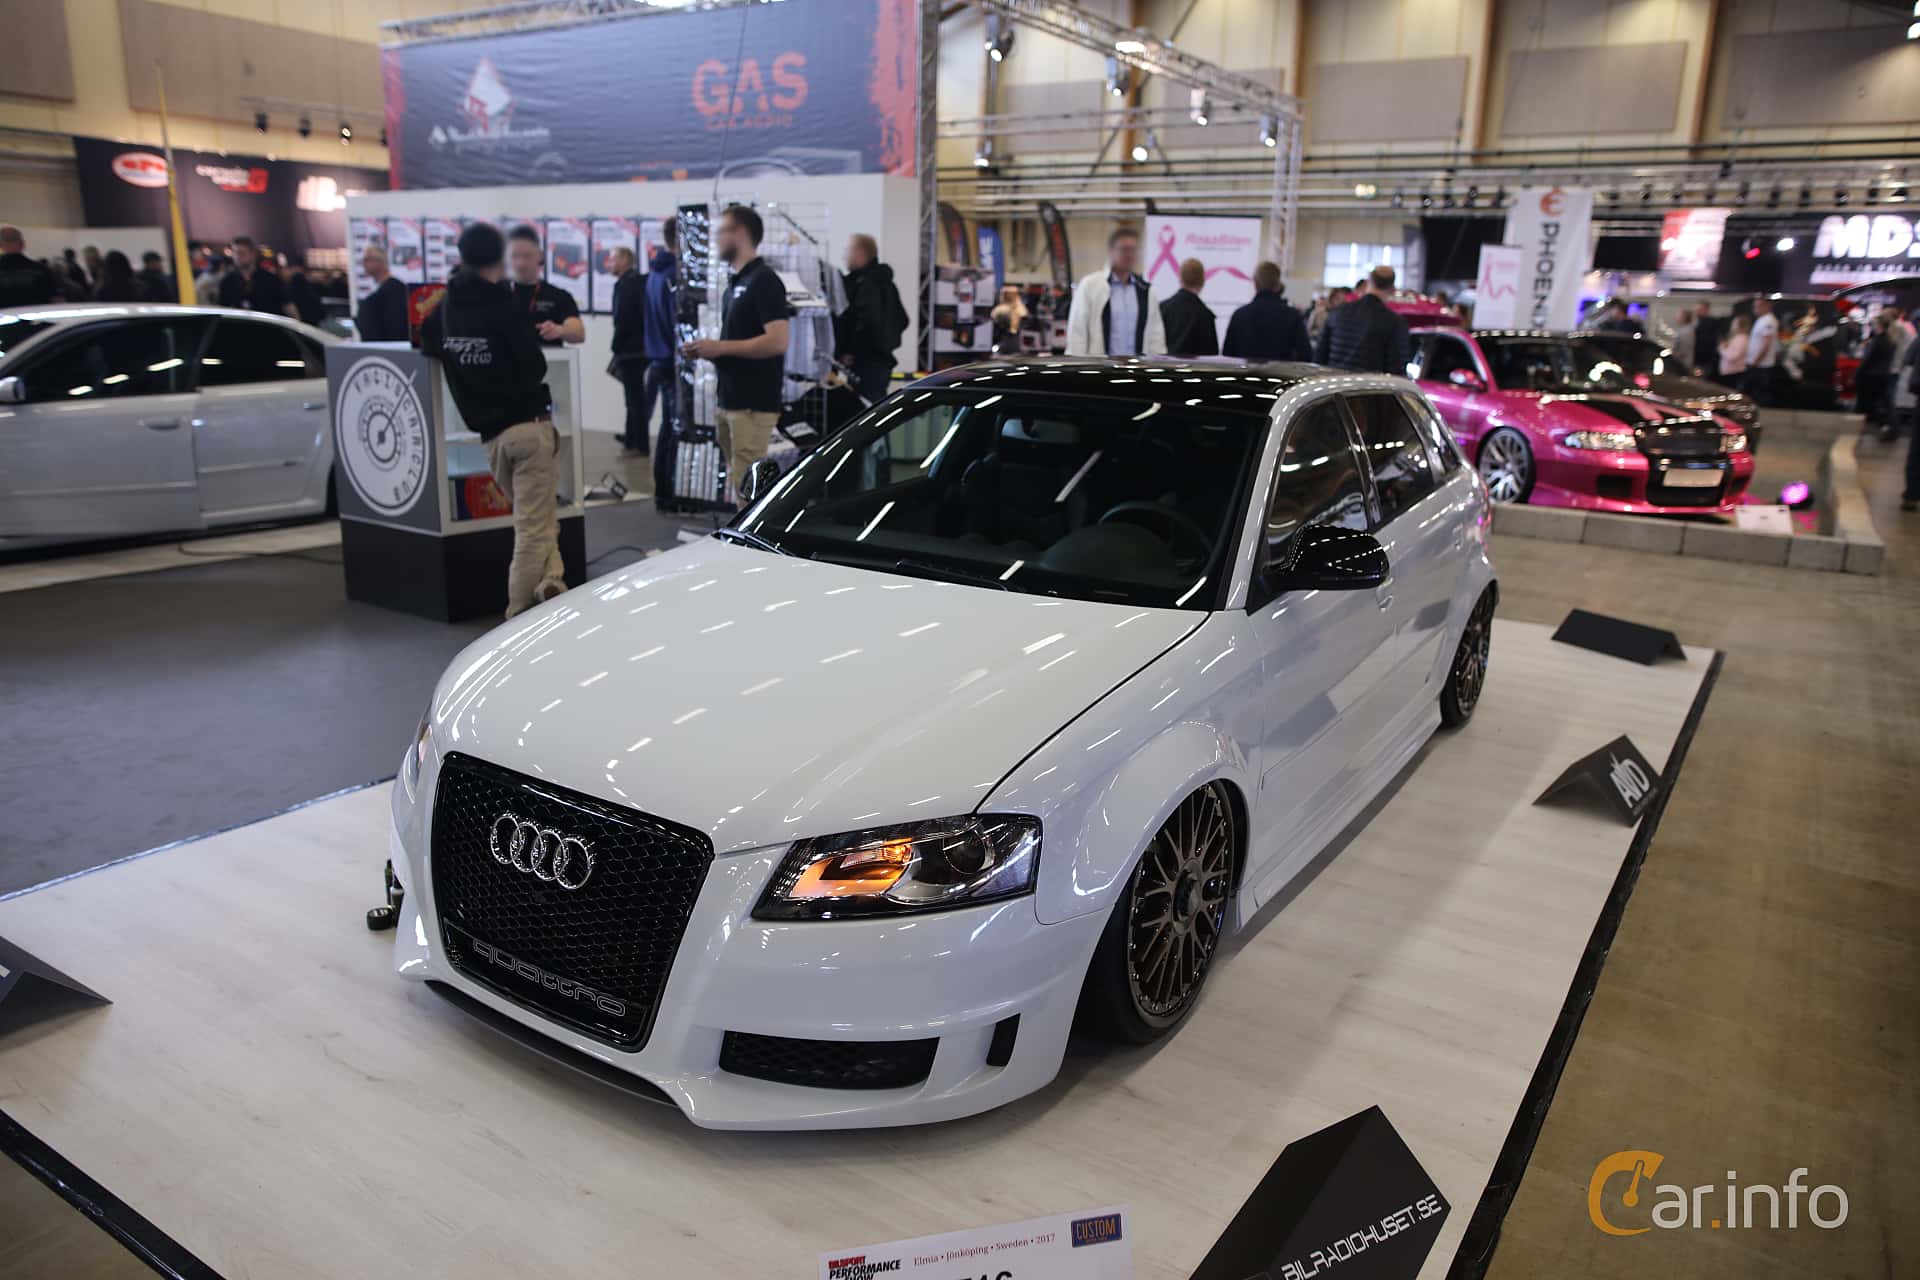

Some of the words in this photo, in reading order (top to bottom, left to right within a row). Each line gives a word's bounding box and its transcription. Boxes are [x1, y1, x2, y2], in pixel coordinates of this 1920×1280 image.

[691, 51, 808, 116] GAS
[472, 938, 626, 1017] quattro
[913, 1255, 940, 1267] Elmia
[945, 1245, 989, 1263] Jönköping
[995, 1237, 1029, 1250] Sweden
[1035, 1231, 1056, 1245] 2017
[1076, 1216, 1116, 1241] CUSTOM
[1280, 1193, 1442, 1280] BILRADIOHUSET.SE
[828, 1259, 902, 1279] PERFORMANCE
